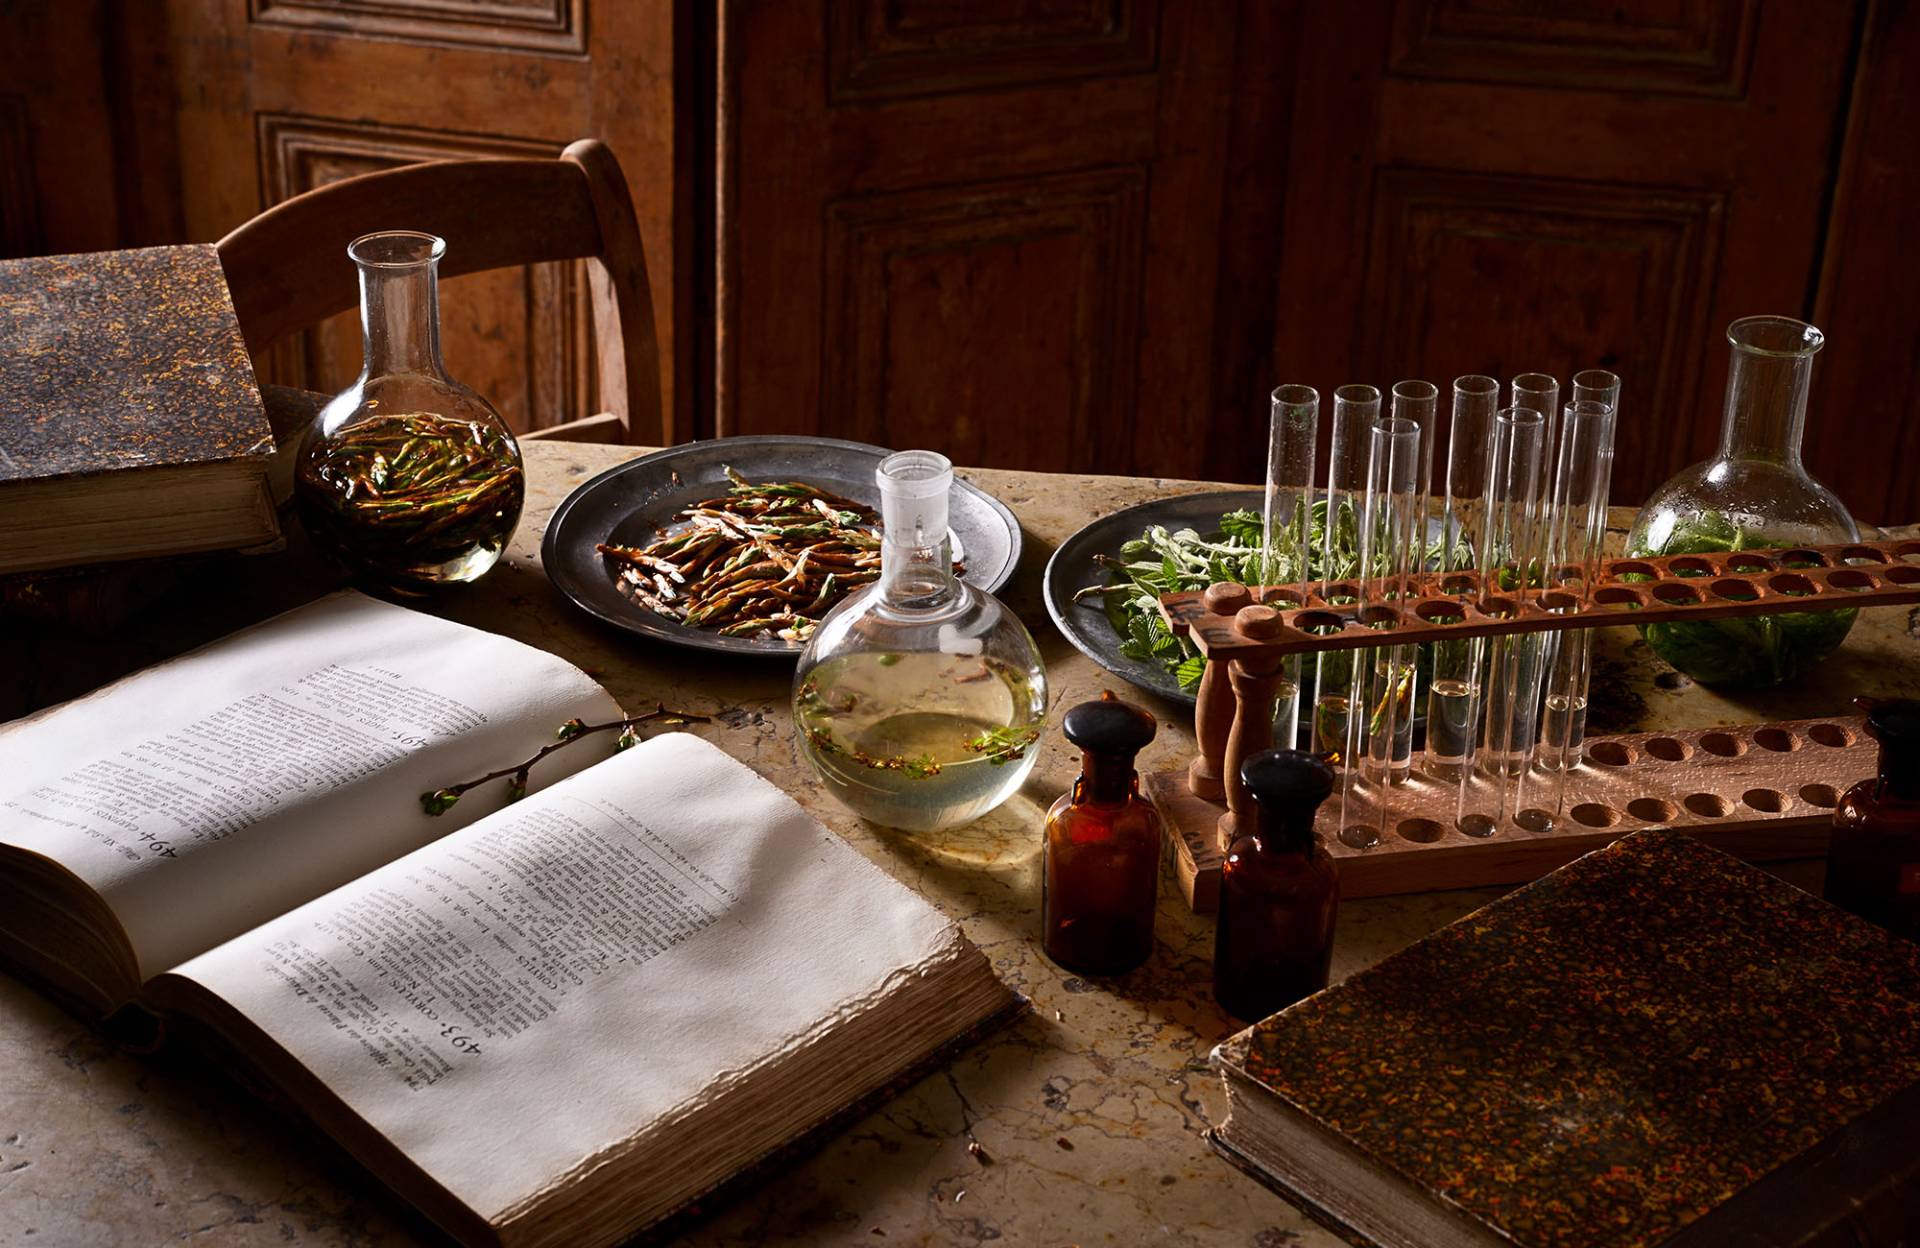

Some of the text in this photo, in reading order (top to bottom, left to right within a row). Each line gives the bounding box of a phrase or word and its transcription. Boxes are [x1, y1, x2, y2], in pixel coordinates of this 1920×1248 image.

[392, 732, 430, 748] 495.
[138, 832, 177, 857] 494.
[516, 956, 557, 990] CORYLUS
[441, 1023, 481, 1054] 493.
